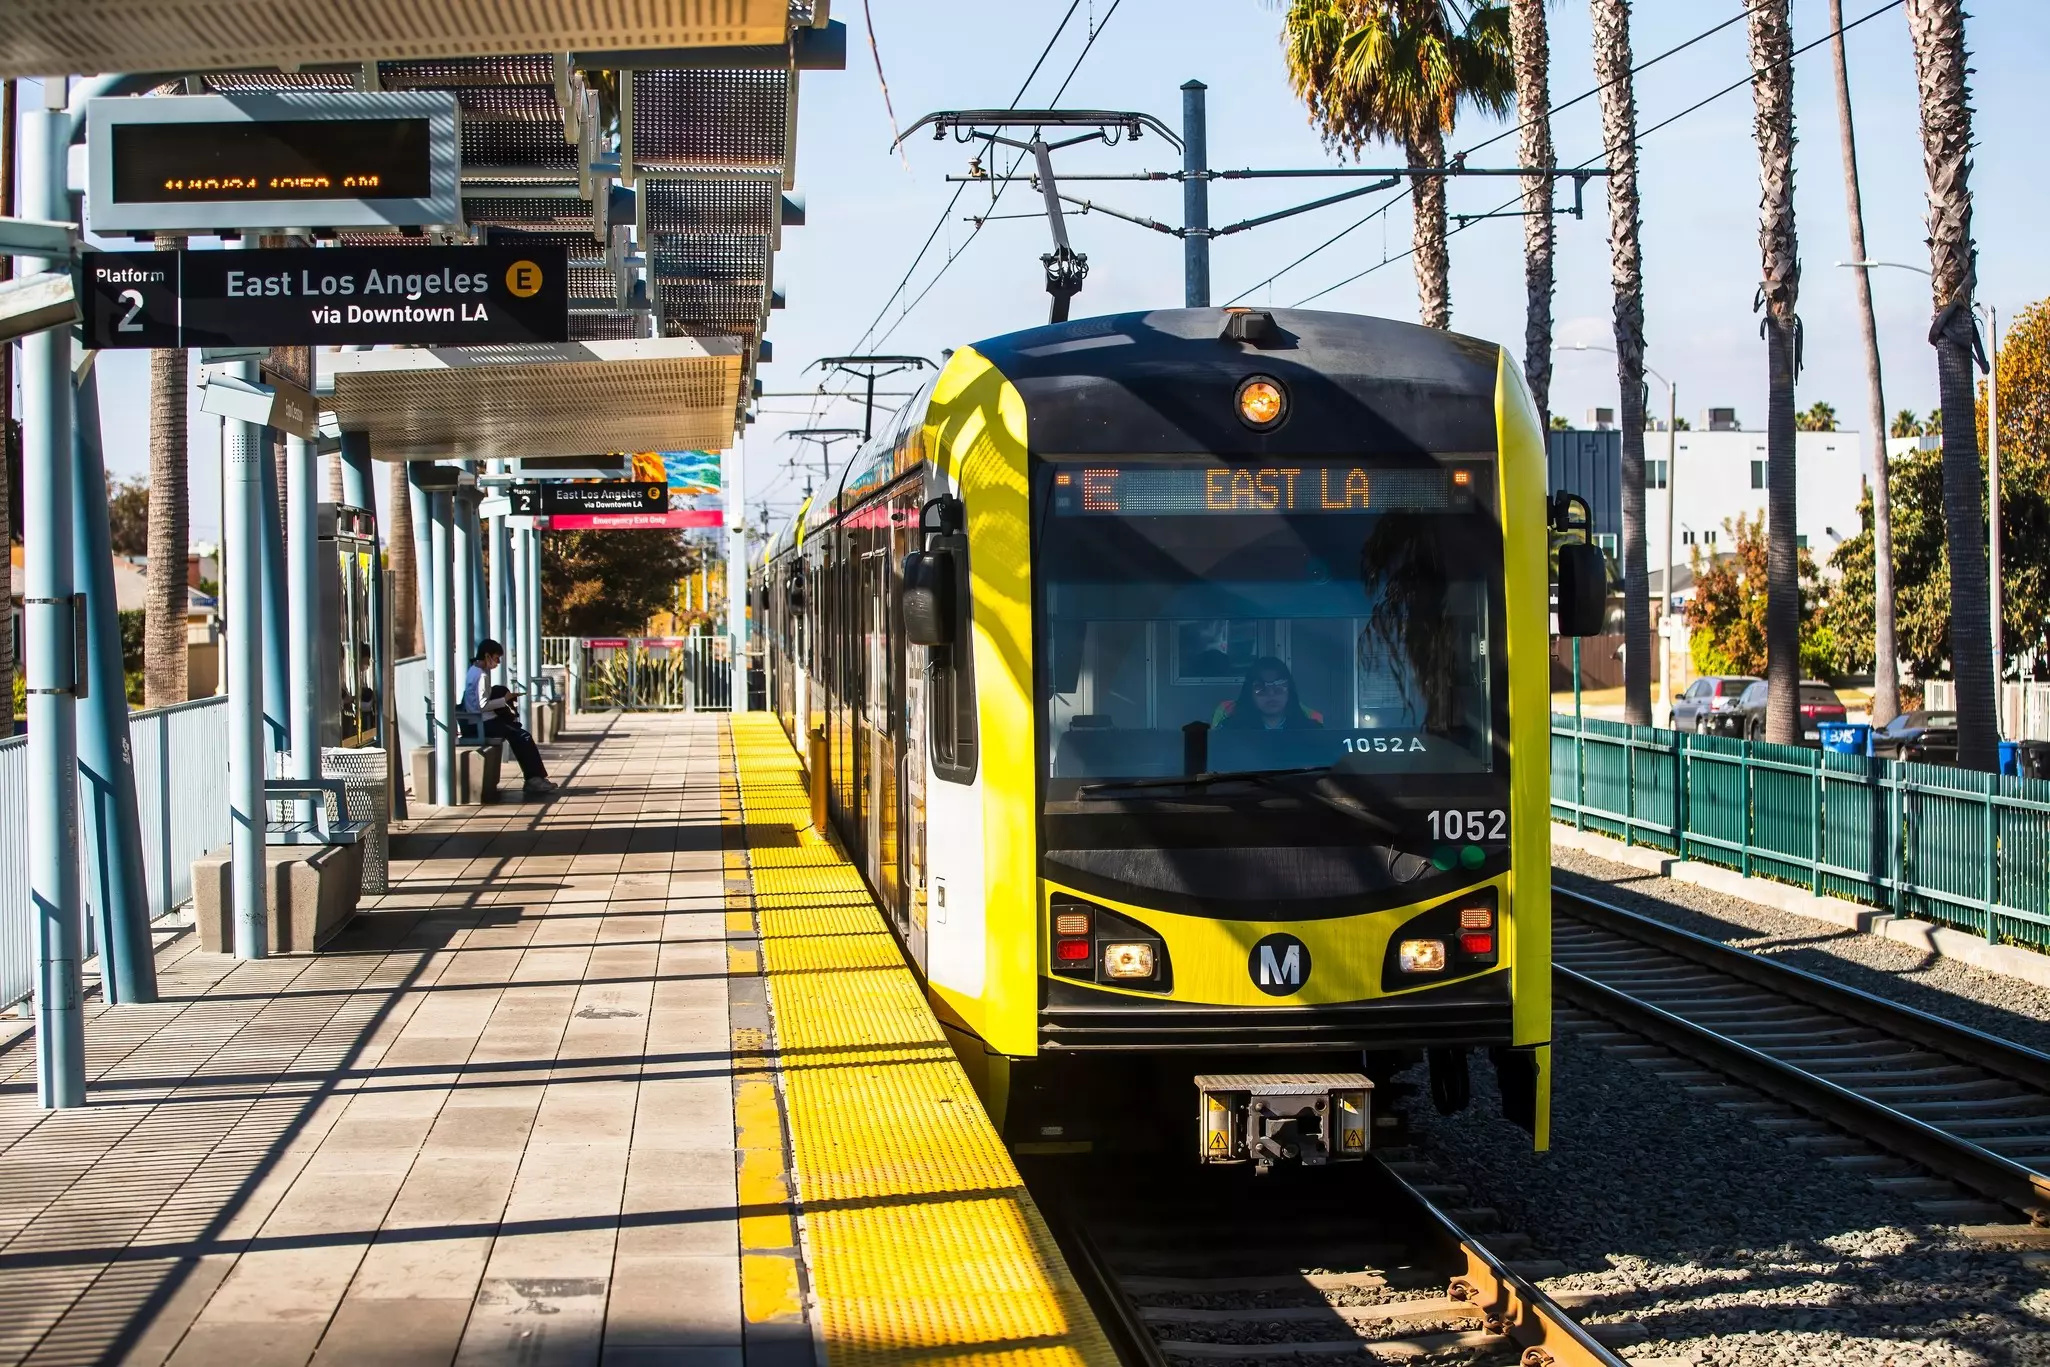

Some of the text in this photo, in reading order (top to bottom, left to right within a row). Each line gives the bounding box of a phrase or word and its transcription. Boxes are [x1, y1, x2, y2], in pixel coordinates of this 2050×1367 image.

[96, 268, 165, 283] Platform
[227, 267, 533, 301] East Los Angeles E
[117, 289, 144, 332] 2
[311, 303, 489, 324] via Downtown LA
[556, 490, 579, 500] East
[581, 489, 599, 499] Los
[601, 489, 643, 501] Angeles
[1083, 467, 1370, 511] E EAST LA
[520, 495, 531, 511] 2
[584, 500, 643, 509] via Downtown LA
[592, 516, 667, 526] Emergency Exit Only
[1342, 736, 1427, 753] 1052A
[1427, 809, 1507, 841] 1052
[1260, 944, 1300, 985] M
